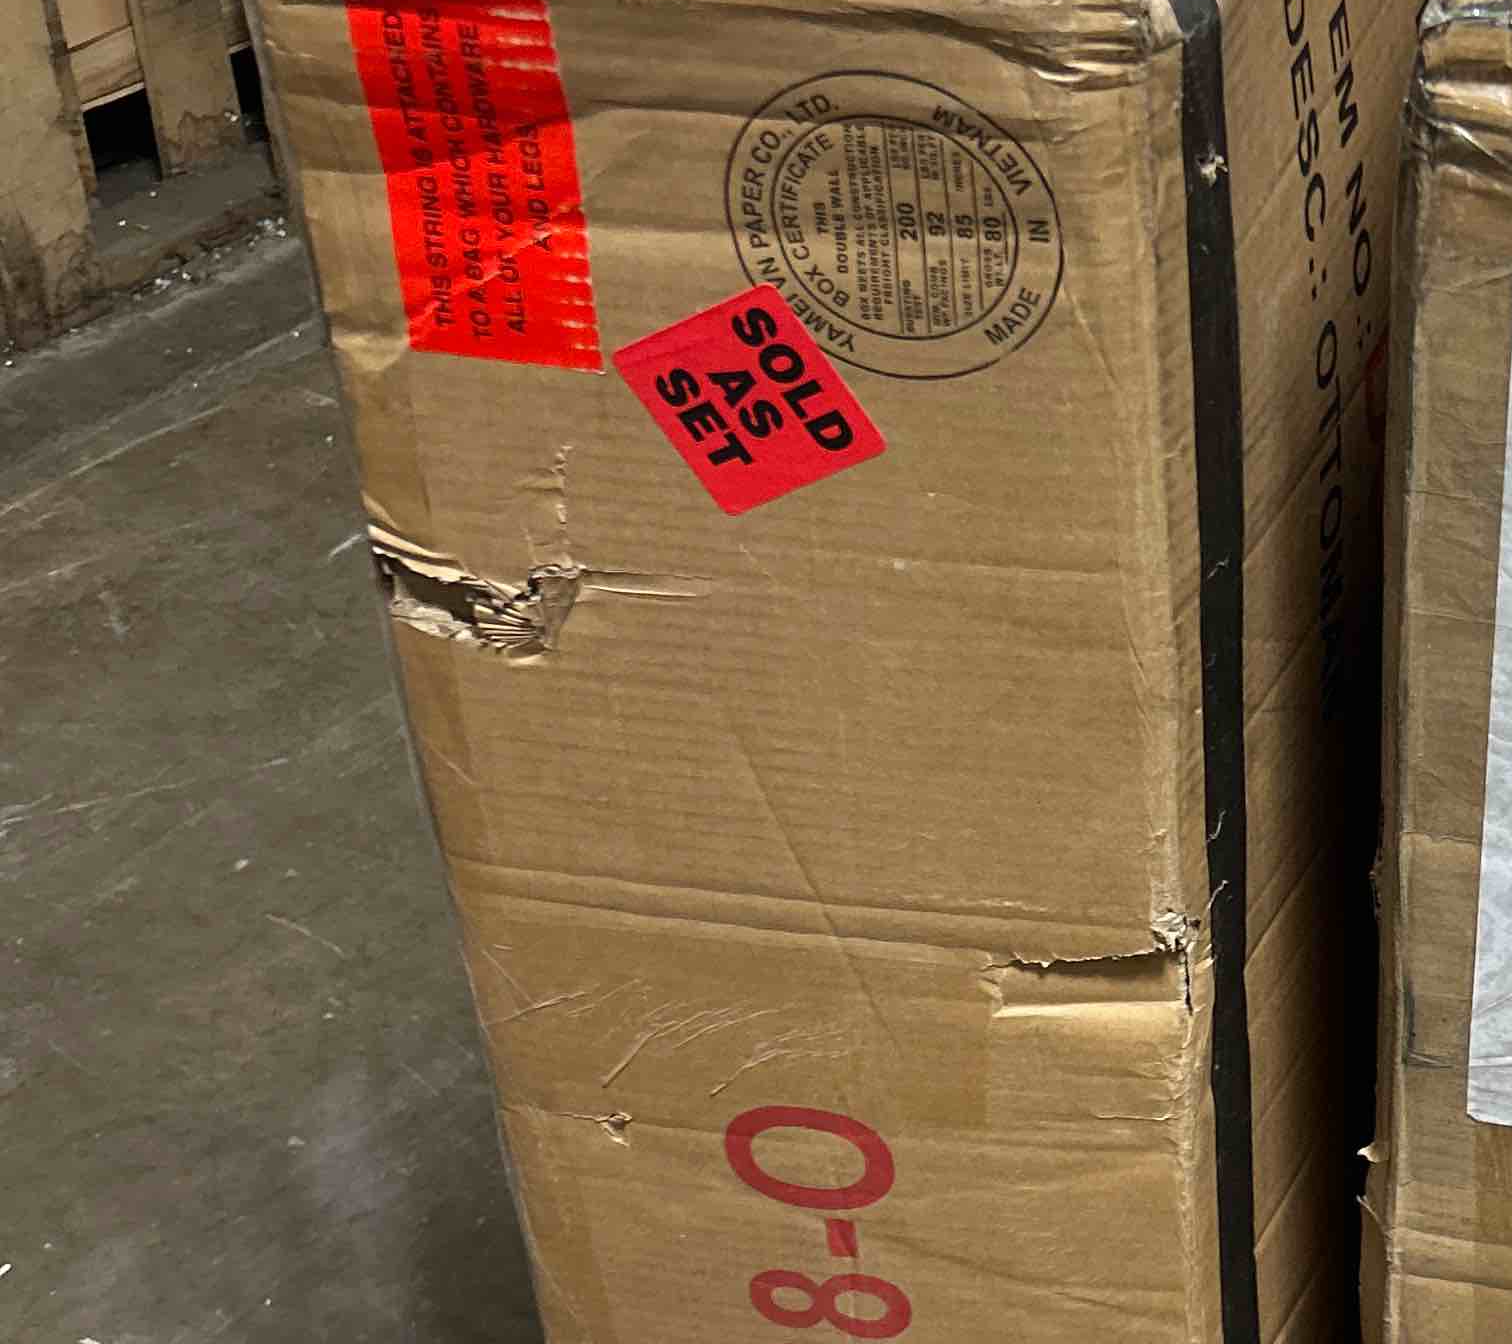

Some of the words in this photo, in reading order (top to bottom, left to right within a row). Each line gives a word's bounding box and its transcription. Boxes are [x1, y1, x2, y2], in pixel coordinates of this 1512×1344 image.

[380, 7, 427, 143] ATTACHED
[418, 6, 463, 132] CONTAINS
[459, 22, 504, 164] HARDWARE
[407, 147, 434, 169] IS
[447, 138, 476, 219] WHICH
[517, 122, 545, 190] LEGS
[741, 168, 770, 249] PAPER
[784, 93, 840, 124] LTD.
[932, 106, 1033, 196] VIETNAM
[488, 171, 516, 240] YOUR
[780, 133, 834, 262] CERTIFICATE
[828, 169, 842, 209] WALL
[415, 173, 448, 268] STRING
[528, 198, 554, 251] AND
[813, 202, 830, 235] THIS
[831, 213, 849, 274] DOUBLE
[896, 202, 918, 240] 200
[927, 211, 946, 236] 92
[955, 215, 973, 239] 85
[983, 217, 1001, 240] 80
[1027, 220, 1050, 244] IN
[459, 227, 484, 282] BAG
[430, 276, 456, 328] THIS
[464, 286, 488, 303] A
[503, 289, 527, 336] ALL
[805, 263, 851, 308] BOX
[467, 308, 494, 338] TO
[983, 286, 1042, 346] MADE
[705, 369, 783, 438] AS
[731, 307, 854, 452] SOLD
[655, 367, 753, 466] SET
